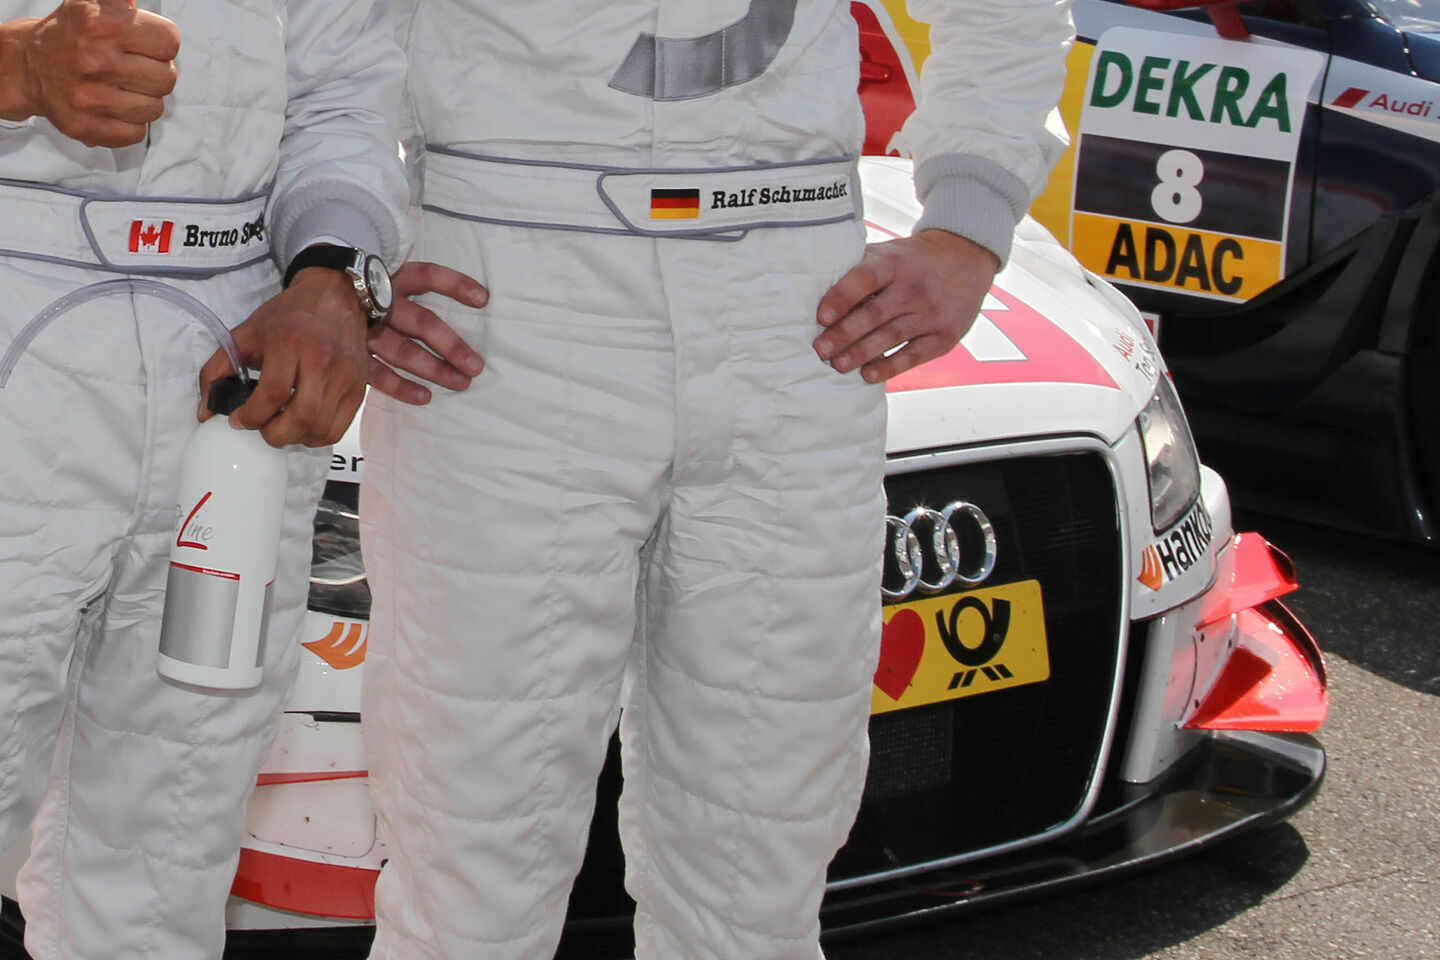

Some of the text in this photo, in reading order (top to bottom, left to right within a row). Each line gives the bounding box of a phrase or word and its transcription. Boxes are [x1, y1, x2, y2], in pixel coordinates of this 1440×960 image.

[1089, 50, 1292, 134] DEKRA
[1368, 92, 1434, 117] Audi
[711, 181, 848, 209] Ralf Schumacher
[1151, 149, 1205, 225] 8
[183, 224, 239, 248] Bruno
[1105, 223, 1244, 296] ADAC
